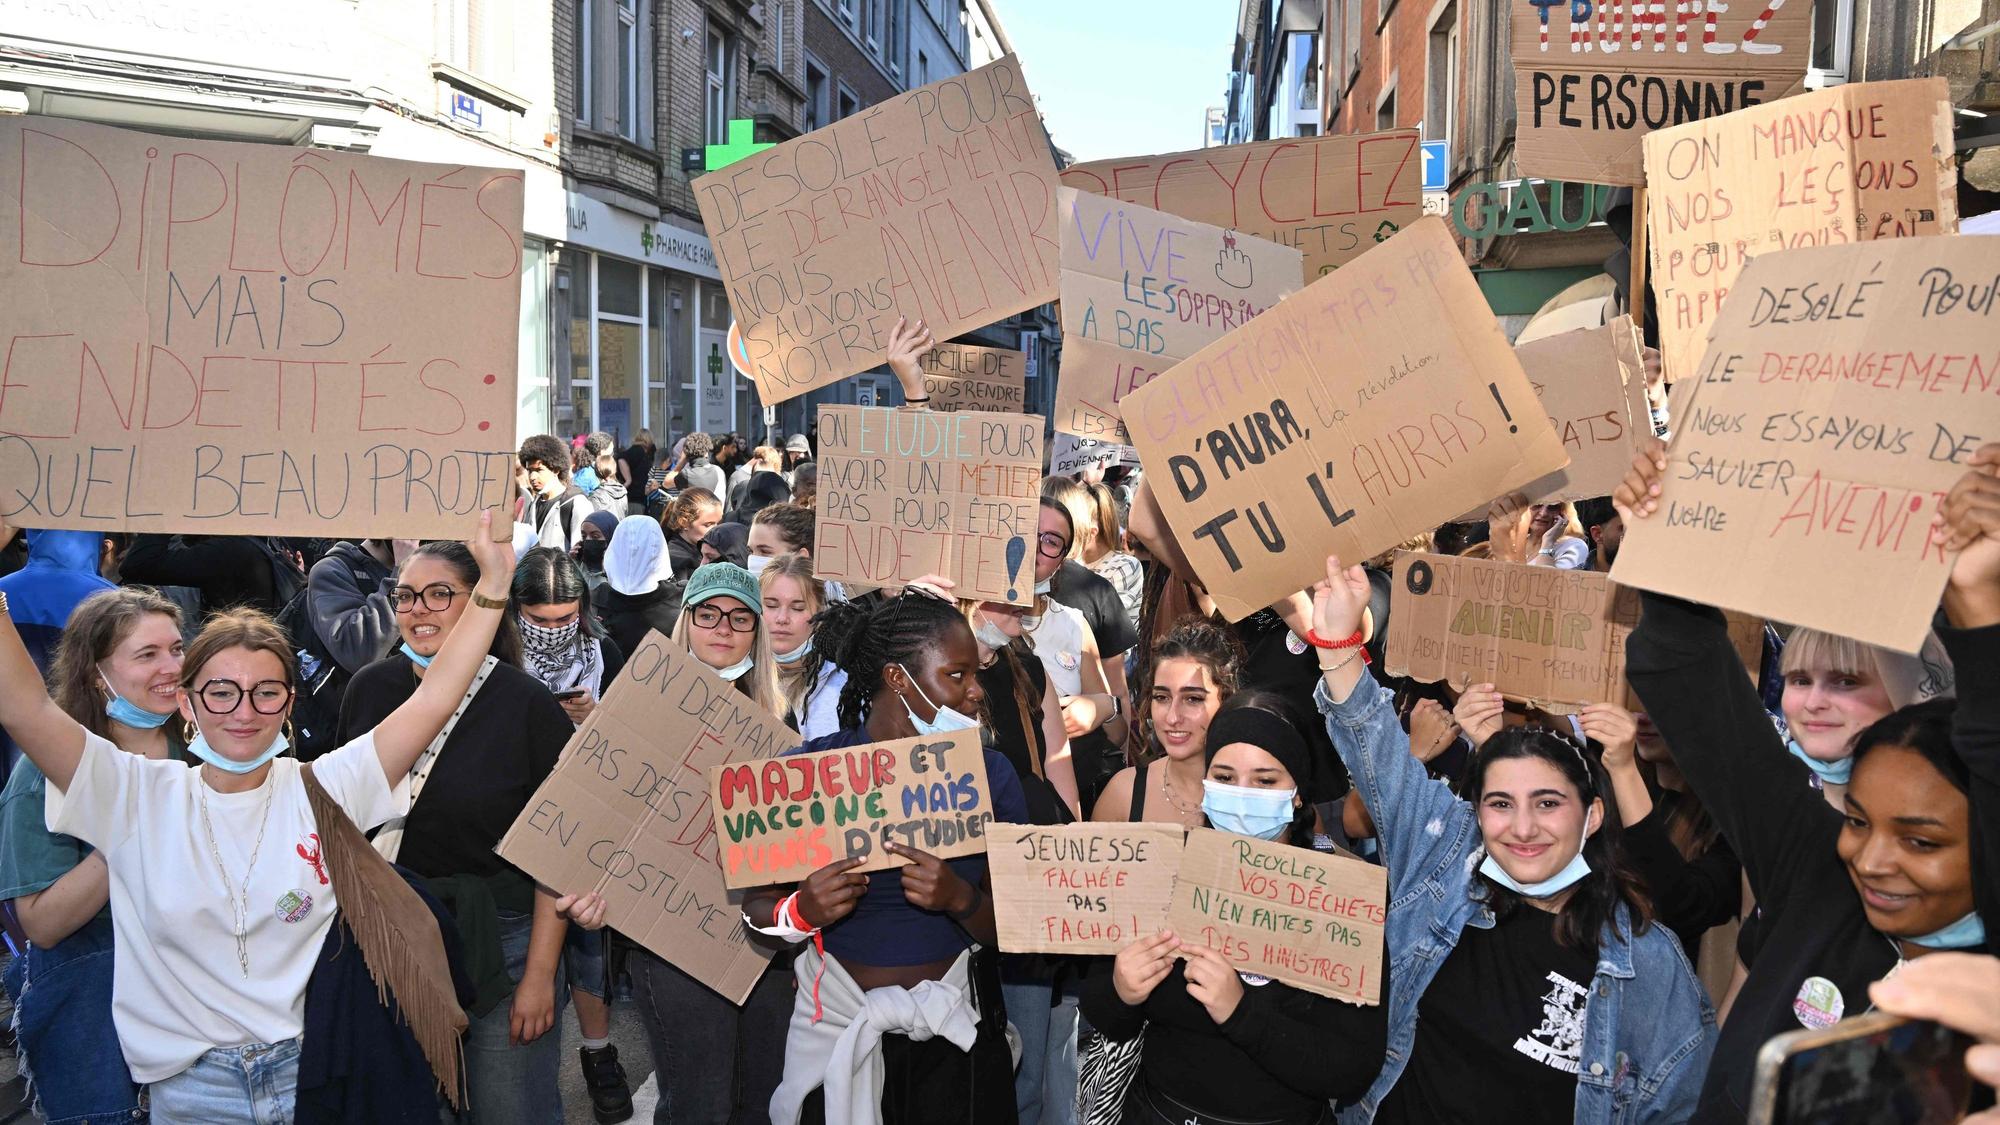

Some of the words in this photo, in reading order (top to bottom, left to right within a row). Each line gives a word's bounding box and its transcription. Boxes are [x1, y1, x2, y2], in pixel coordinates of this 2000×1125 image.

[702, 106, 899, 237] DESOLÉ
[905, 65, 1034, 145] POUR
[1666, 132, 1721, 181] ON
[1752, 103, 1888, 161] MANQUE
[718, 222, 774, 283] LE
[777, 109, 1040, 259] DERANGEMENT
[1664, 187, 1734, 235] NOS
[656, 233, 698, 263] PHARMACIE
[1669, 239, 1748, 281] POUR
[732, 253, 834, 325] NOUS
[758, 314, 890, 396] NOTRE
[879, 171, 1061, 327] AVENIR
[1123, 269, 1178, 313] LES
[745, 277, 893, 361] SAUVONS
[1082, 296, 1099, 342] À
[1115, 309, 1166, 355] BAS
[982, 352, 1015, 378] DE
[1705, 350, 1744, 384] LE
[1757, 350, 2000, 395] DERANGEMEN
[962, 380, 1021, 403] RENDRE
[818, 412, 849, 448] ON
[980, 420, 1037, 459] POUR
[1071, 408, 1106, 435] LES
[1690, 406, 1748, 436] NOUS
[1760, 412, 1913, 457] ESSAYONS
[1929, 422, 1983, 465] DE
[0, 435, 163, 520] QUEL
[183, 444, 351, 520] BEAU
[364, 444, 518, 519] PROJET
[819, 456, 888, 492] AVOIR
[907, 460, 942, 495] UN
[959, 458, 1041, 499] MÉTIER
[1677, 450, 1796, 497] SAUVER
[826, 490, 872, 522] PAS
[893, 497, 951, 532] POUR
[967, 497, 1033, 536] ÊTRE
[1192, 500, 1287, 575] TU
[1406, 559, 1462, 598] ON
[629, 642, 683, 695] ON
[678, 682, 796, 760] DEMAN
[574, 728, 627, 782] PAS
[621, 761, 694, 824] DES
[719, 747, 897, 812] MAJEUR
[909, 739, 956, 775] ET
[527, 799, 581, 848] EN
[586, 838, 728, 941] COSTUME
[1015, 831, 1151, 864] JEUNESSE
[1232, 838, 1329, 886] RECYCLEZ
[1042, 866, 1129, 890] FACHÉE
[1237, 867, 1279, 901] VOS
[1287, 884, 1387, 925] DÉCHETS
[1066, 893, 1108, 914] PAS
[1192, 885, 1245, 925] N'EN
[1324, 919, 1363, 948] PAS
[1200, 924, 1250, 962] DES
